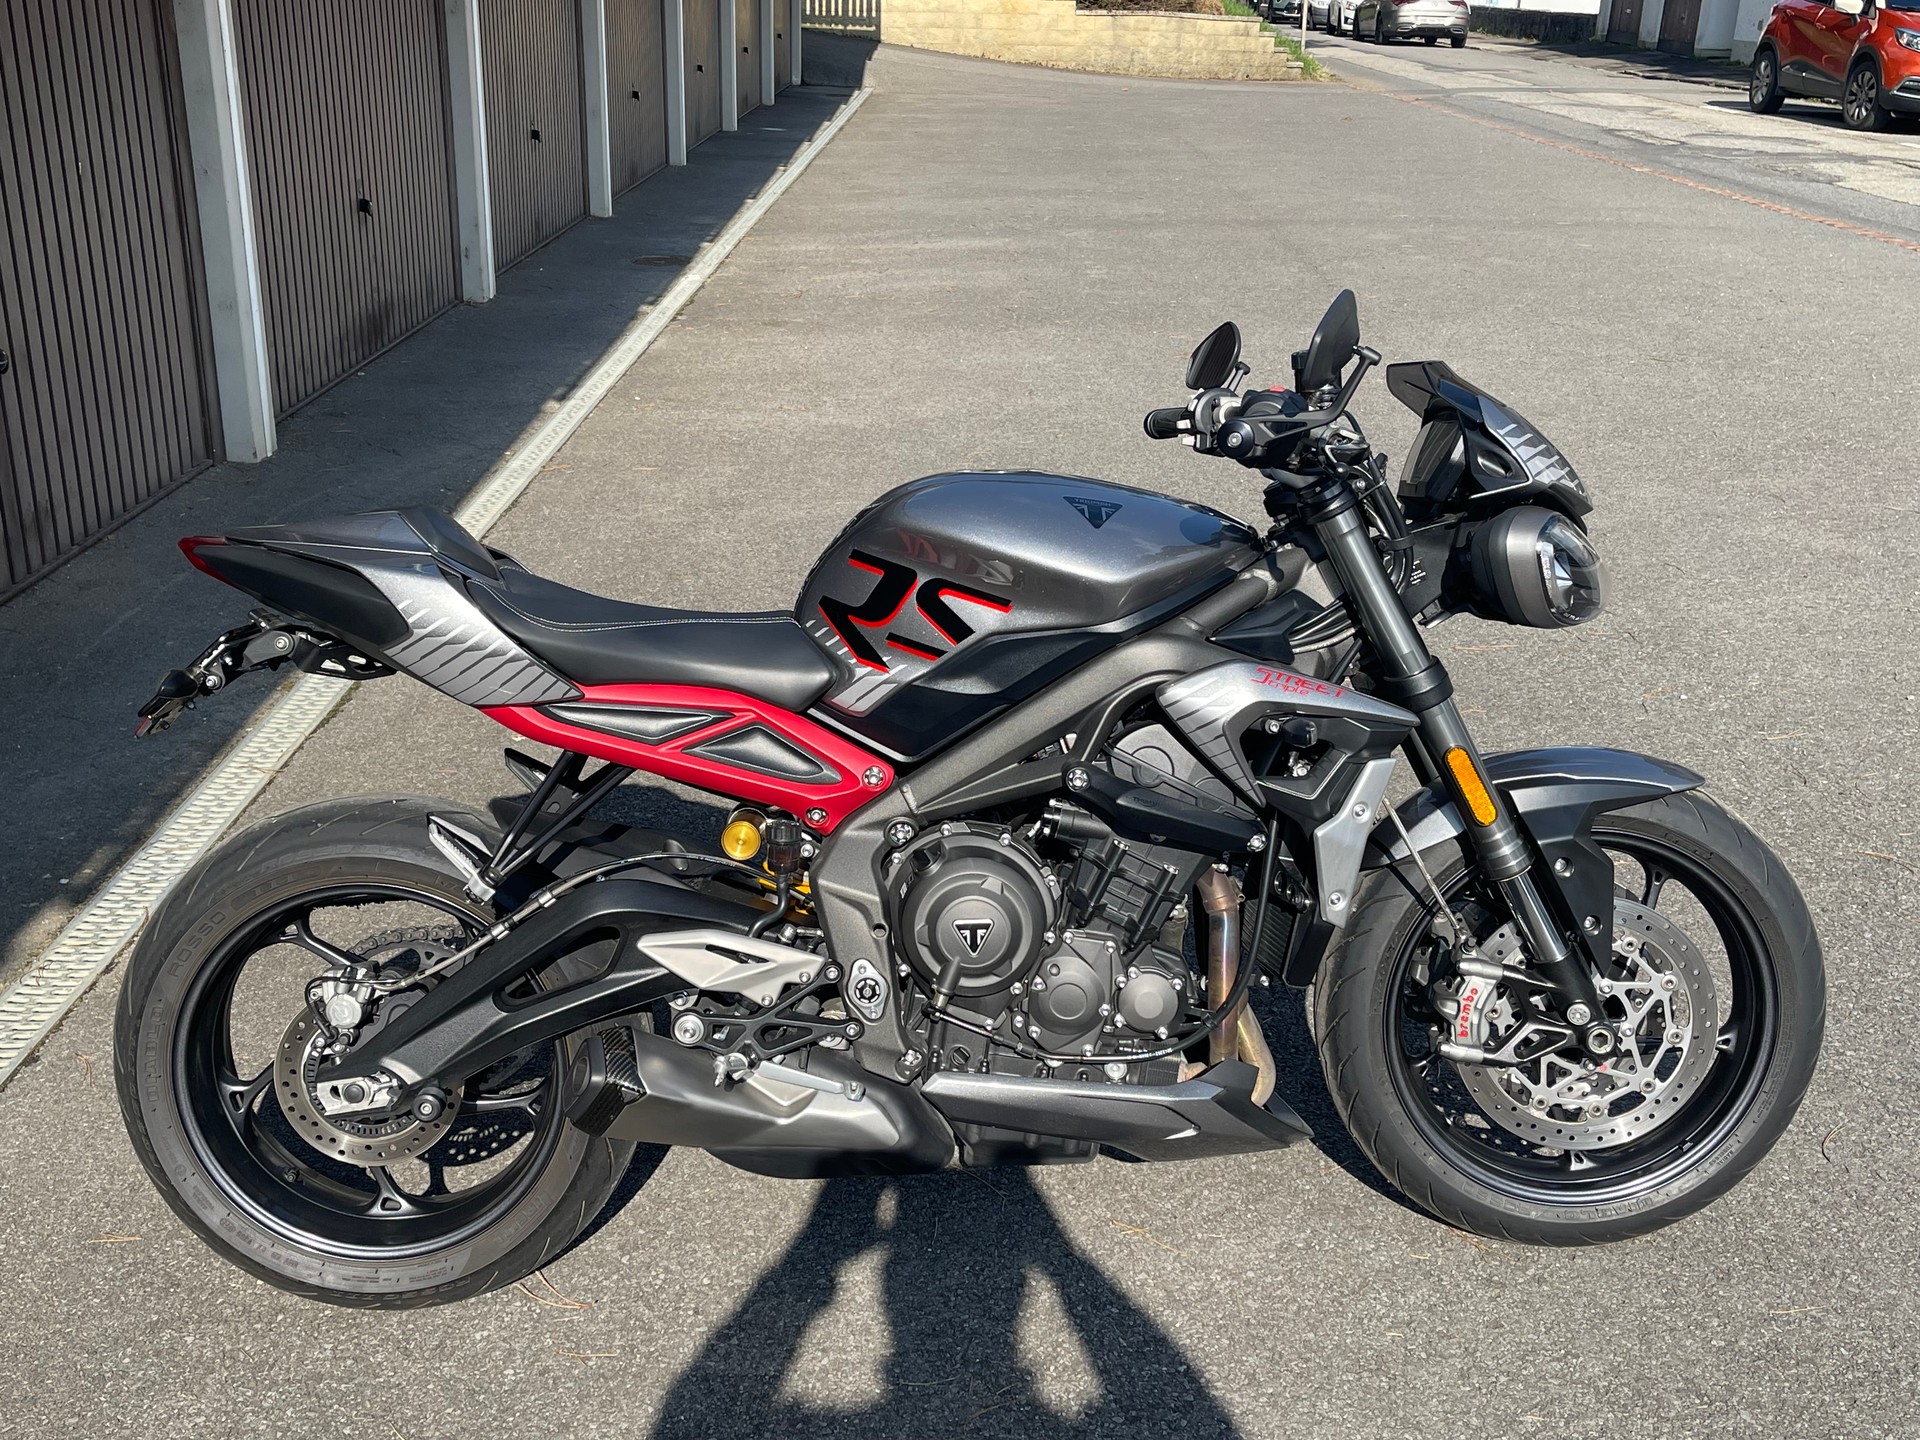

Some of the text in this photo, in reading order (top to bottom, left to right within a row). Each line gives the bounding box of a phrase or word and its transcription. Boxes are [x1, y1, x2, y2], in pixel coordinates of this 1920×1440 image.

[818, 548, 1013, 674] RS
[1250, 666, 1345, 698] STREET
[167, 911, 226, 978] ROSSO
[1458, 987, 1479, 1038] brembo
